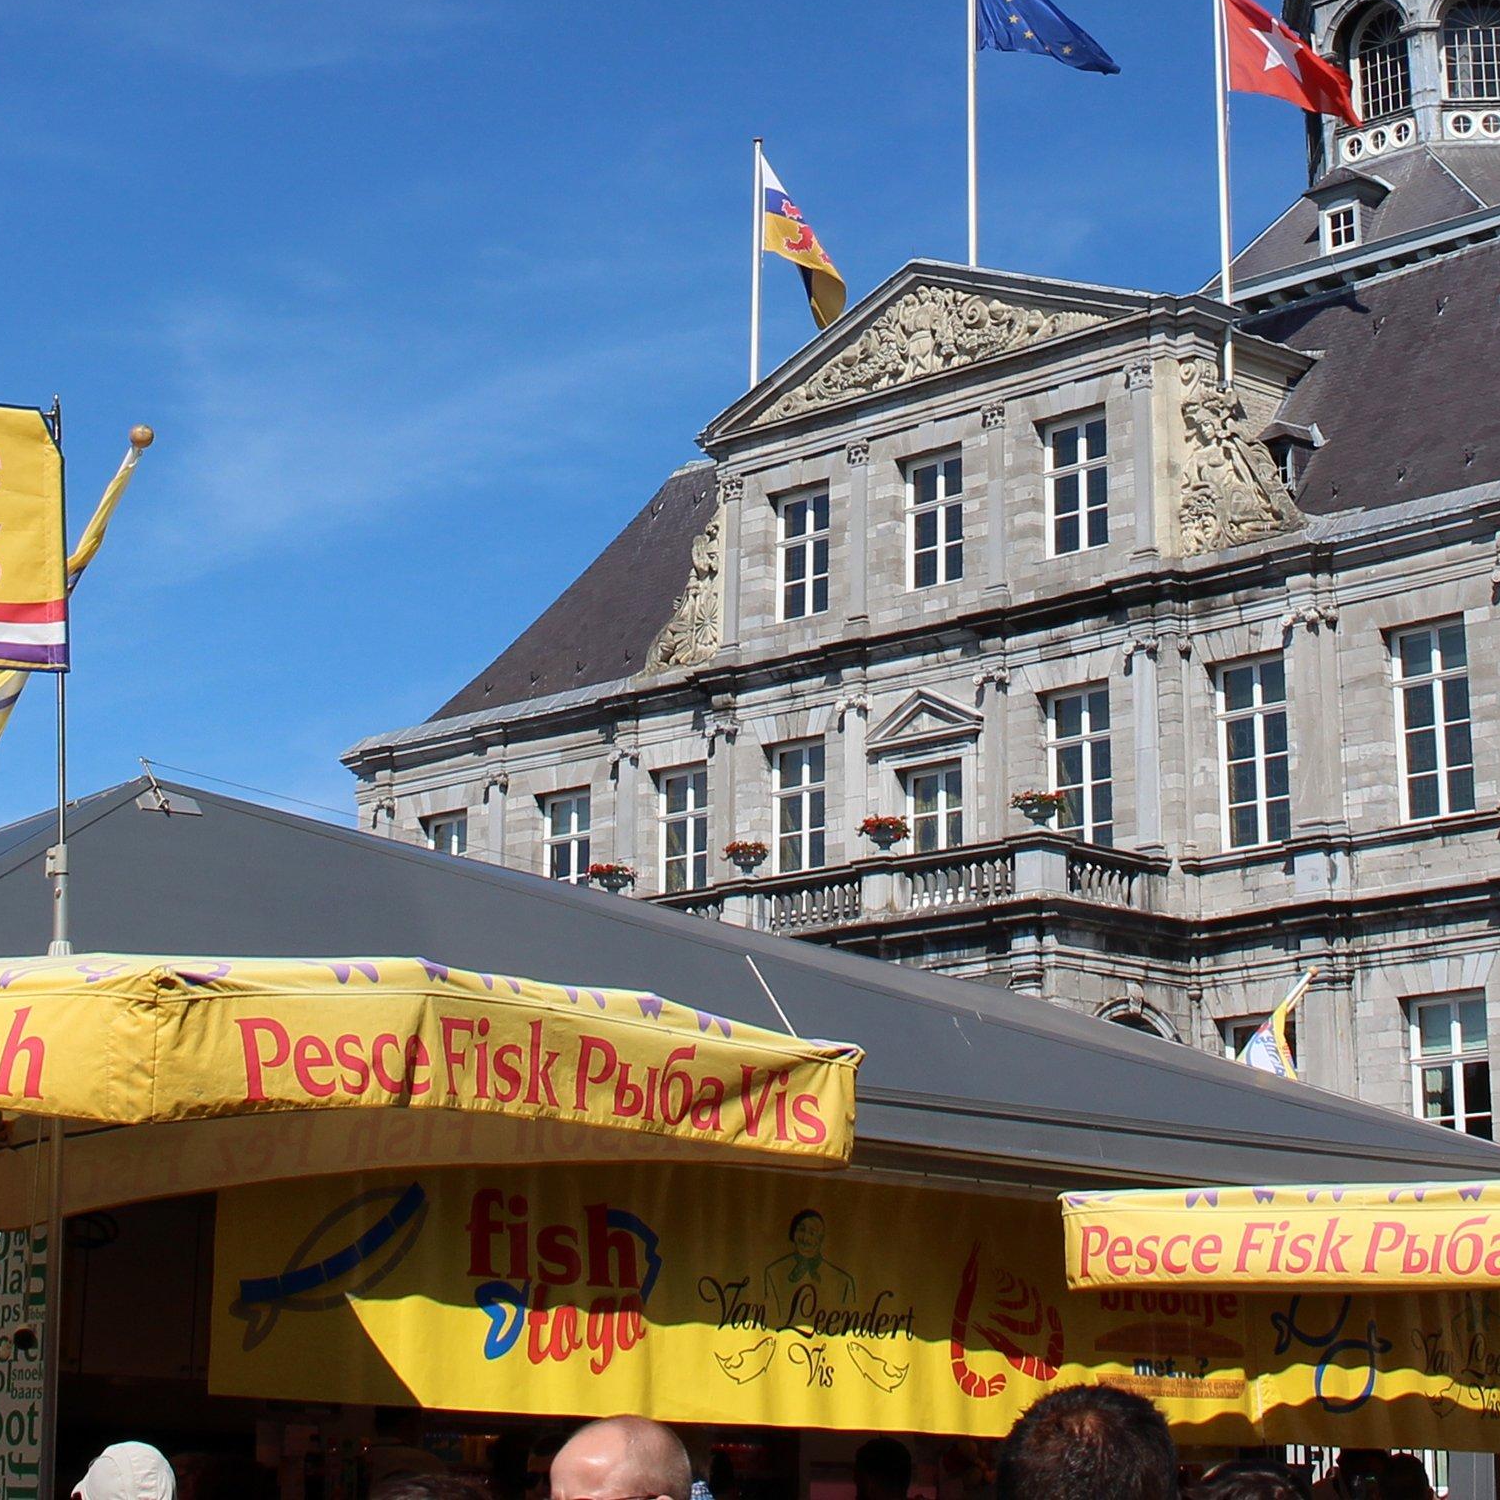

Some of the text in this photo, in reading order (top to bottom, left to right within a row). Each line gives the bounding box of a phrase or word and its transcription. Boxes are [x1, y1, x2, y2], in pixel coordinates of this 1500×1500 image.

[234, 1017, 431, 1101] Pesce
[440, 1017, 560, 1108] Fisk
[739, 1064, 827, 1145] Vis
[465, 1188, 640, 1290] fish
[1080, 1225, 1222, 1279] Pesce
[1232, 1217, 1355, 1275] Fisk
[527, 1282, 646, 1375] to go
[698, 1275, 917, 1342] Van Leendert
[788, 1342, 835, 1389] Vis
[1412, 1328, 1454, 1373] Van
[11, 1383, 42, 1399] baars
[1468, 1380, 1500, 1421] Vis
